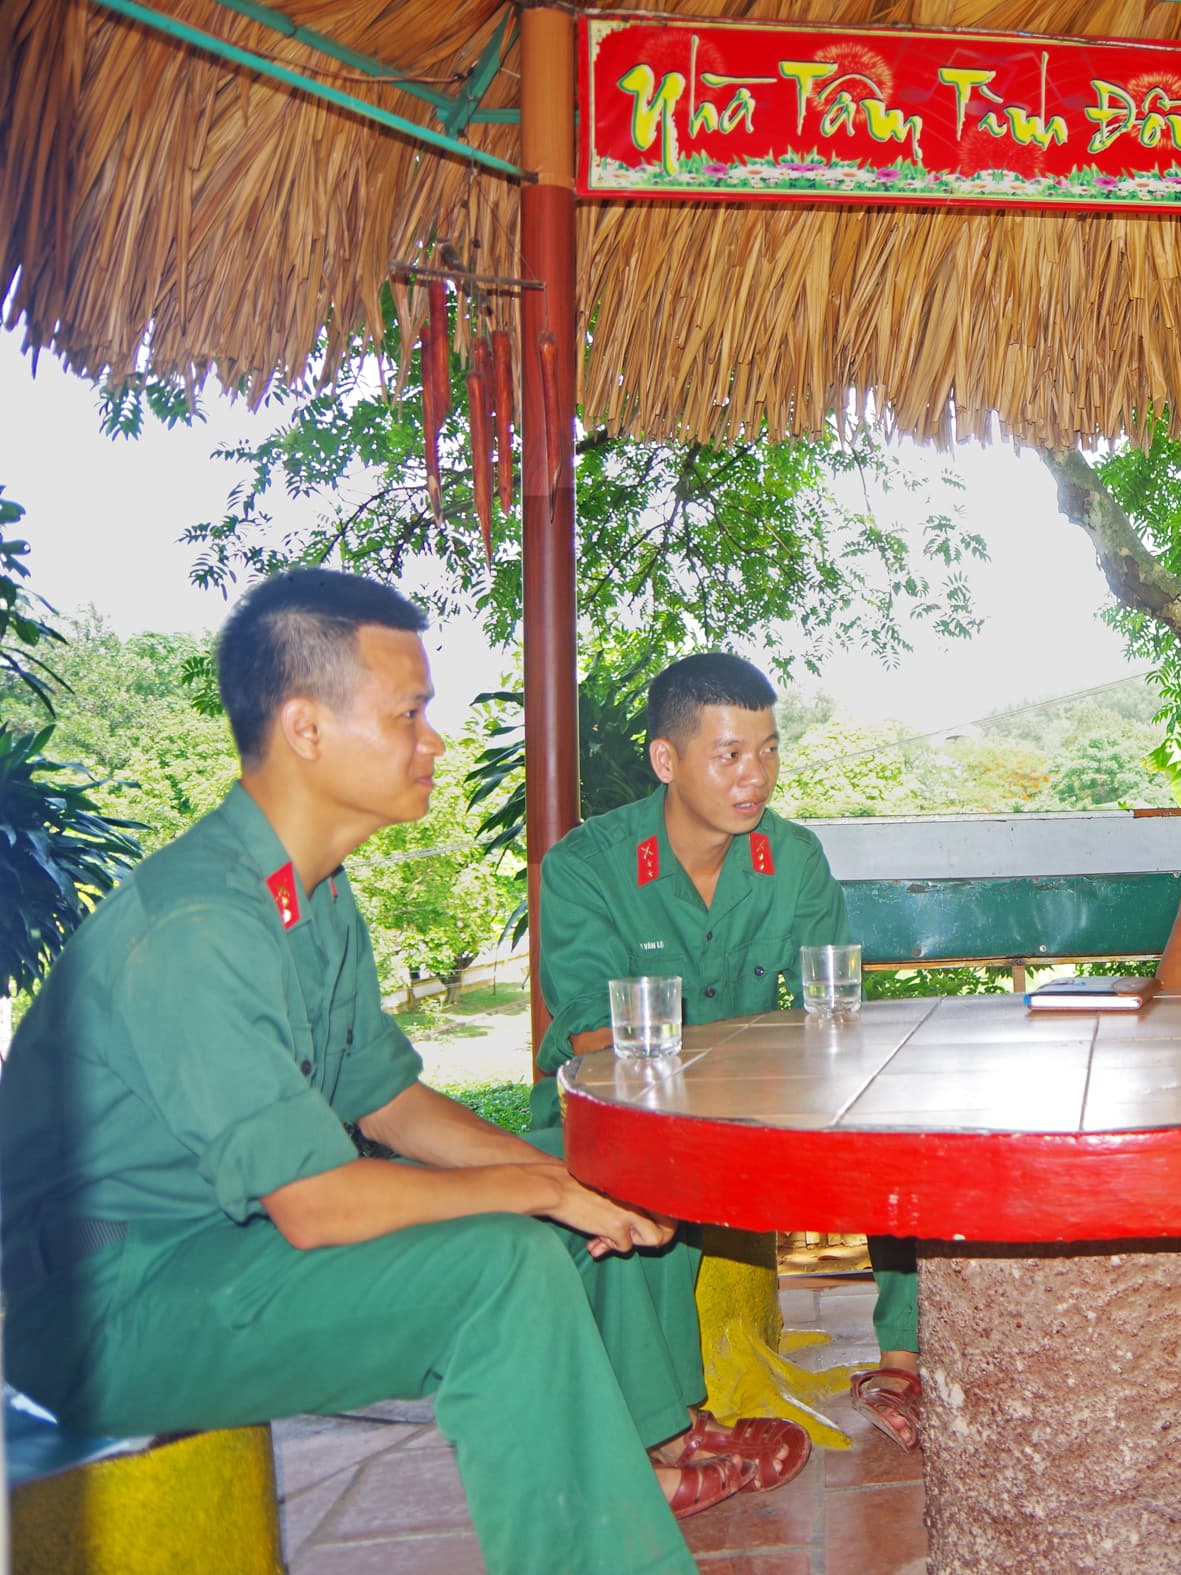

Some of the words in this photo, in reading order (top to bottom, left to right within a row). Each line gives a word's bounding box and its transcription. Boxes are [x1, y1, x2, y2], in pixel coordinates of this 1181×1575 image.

[616, 33, 778, 176] Nhà
[779, 60, 923, 160] Tâm
[938, 51, 1068, 150] Tình
